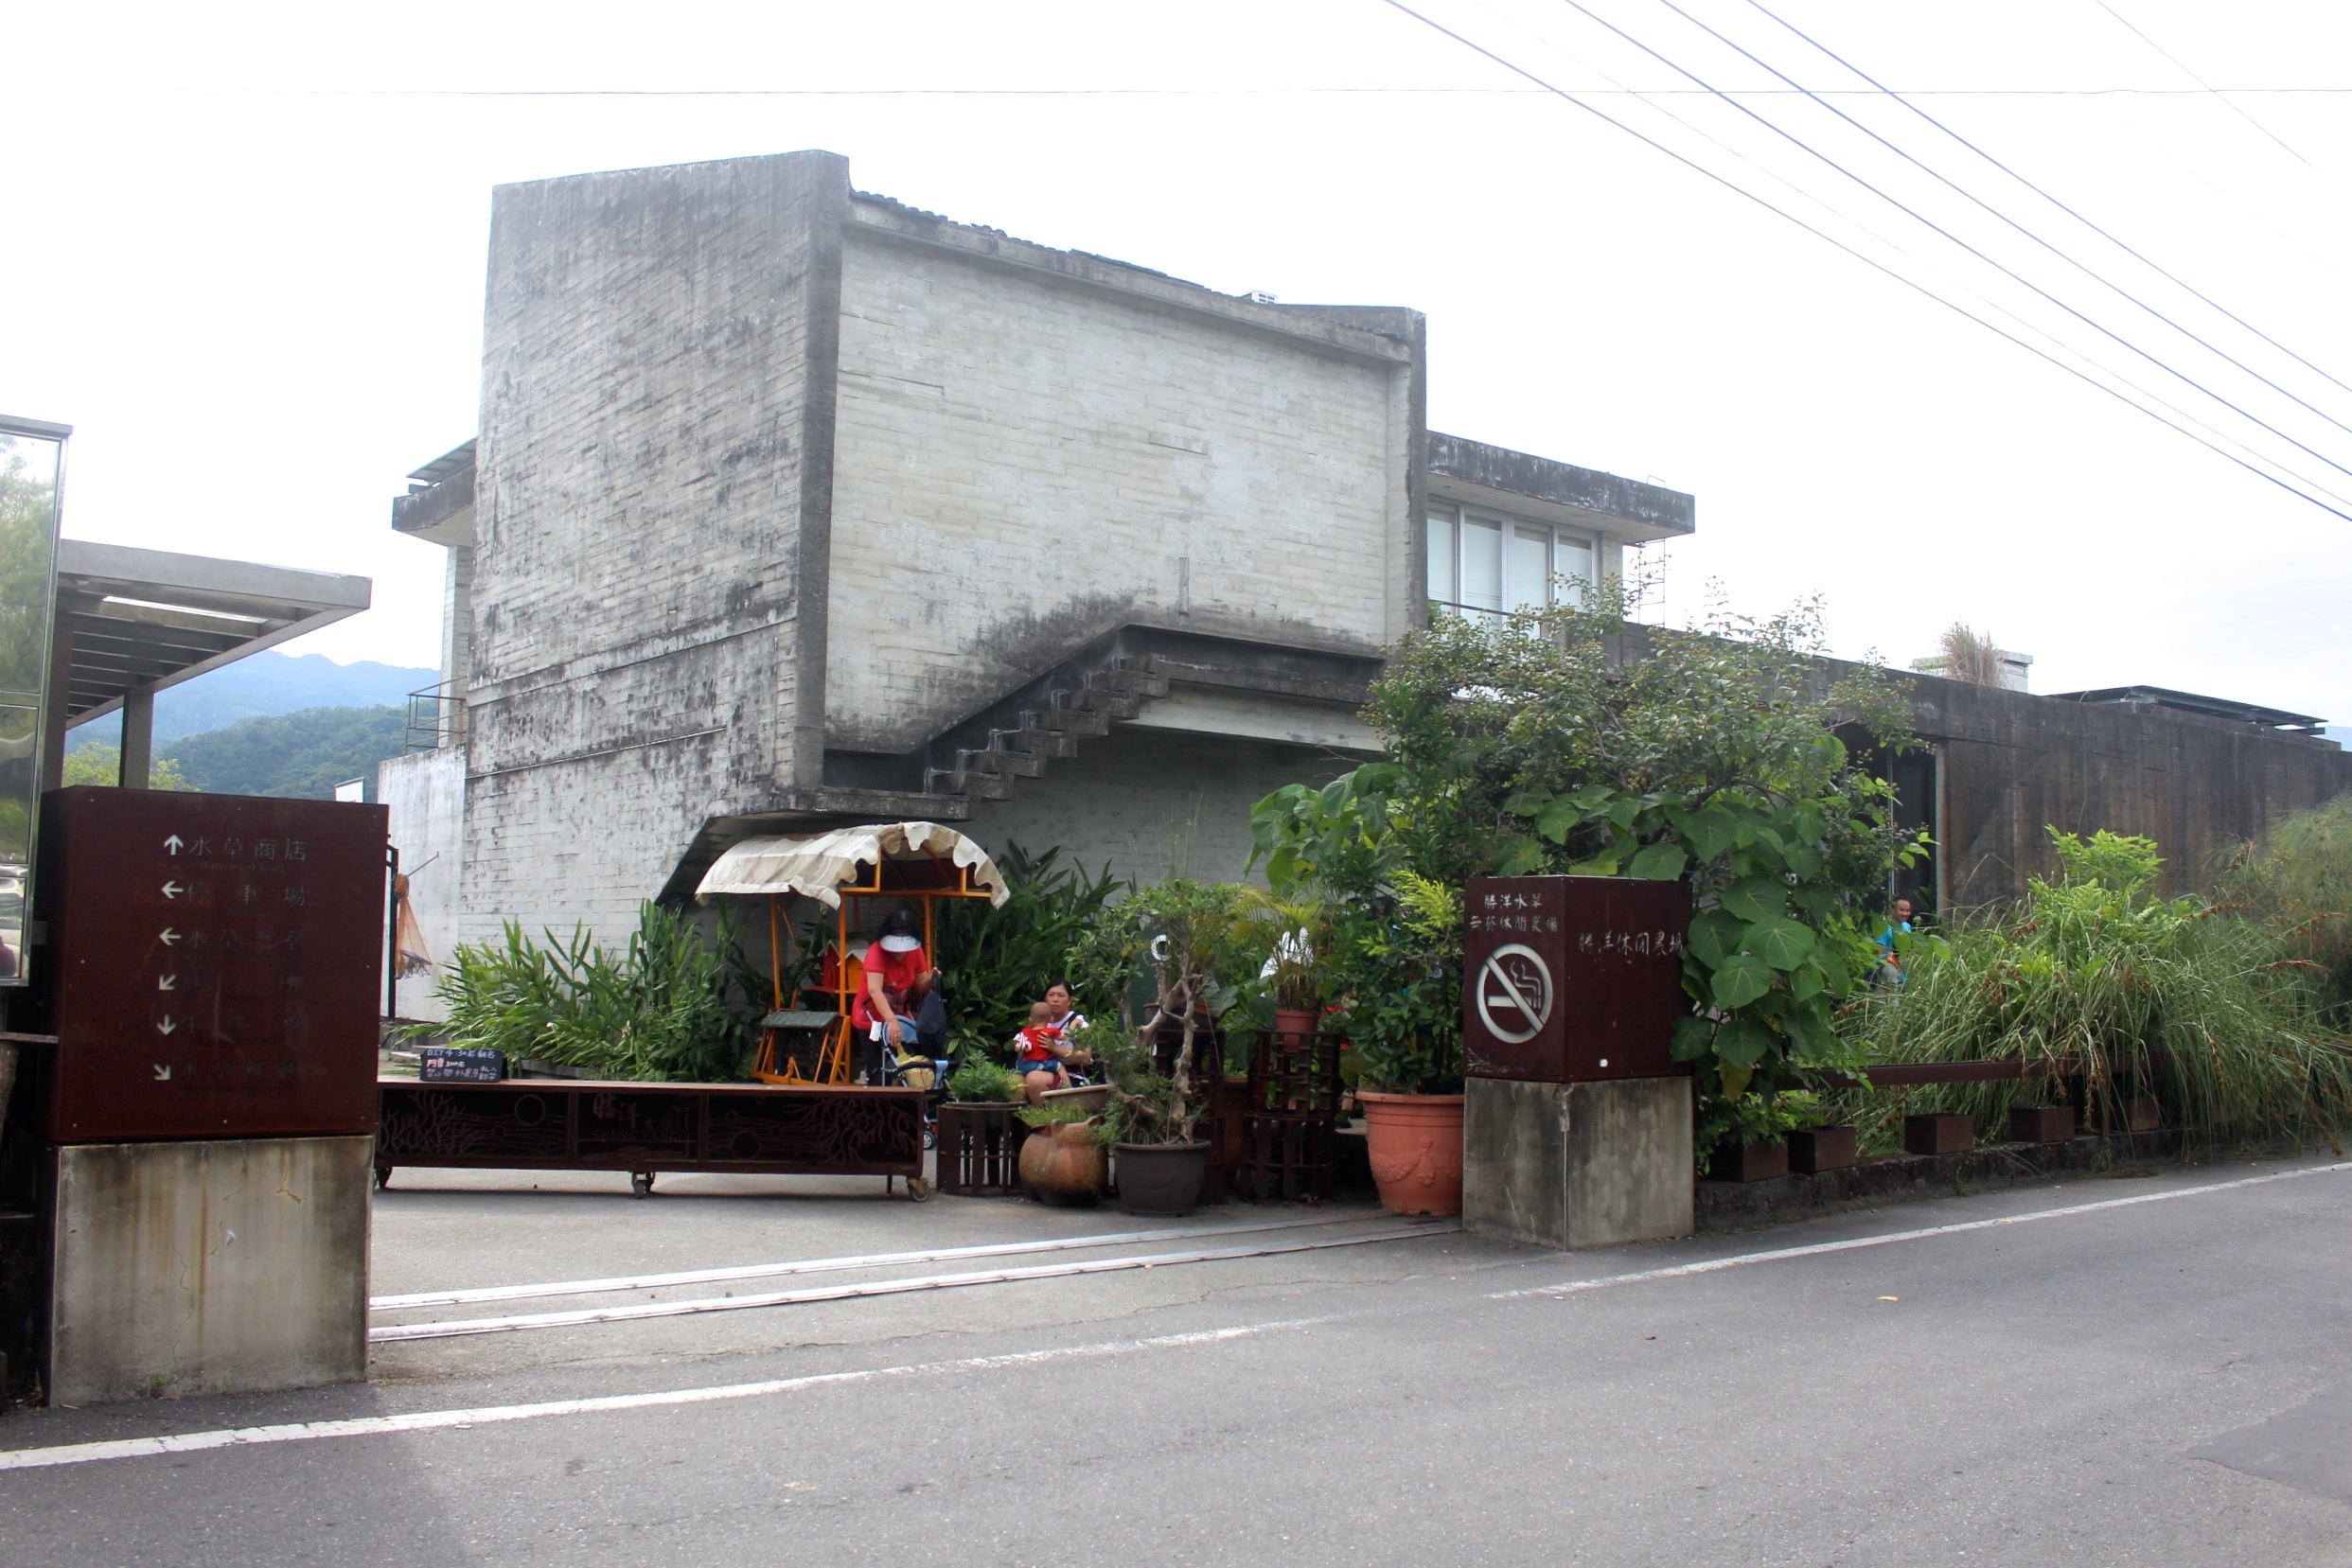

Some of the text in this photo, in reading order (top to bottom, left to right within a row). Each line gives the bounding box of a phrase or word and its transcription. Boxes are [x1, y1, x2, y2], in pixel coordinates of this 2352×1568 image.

[188, 835, 309, 862] 水草商店
[186, 881, 308, 907] 停車場
[1484, 892, 1543, 909] 勝洋水草
